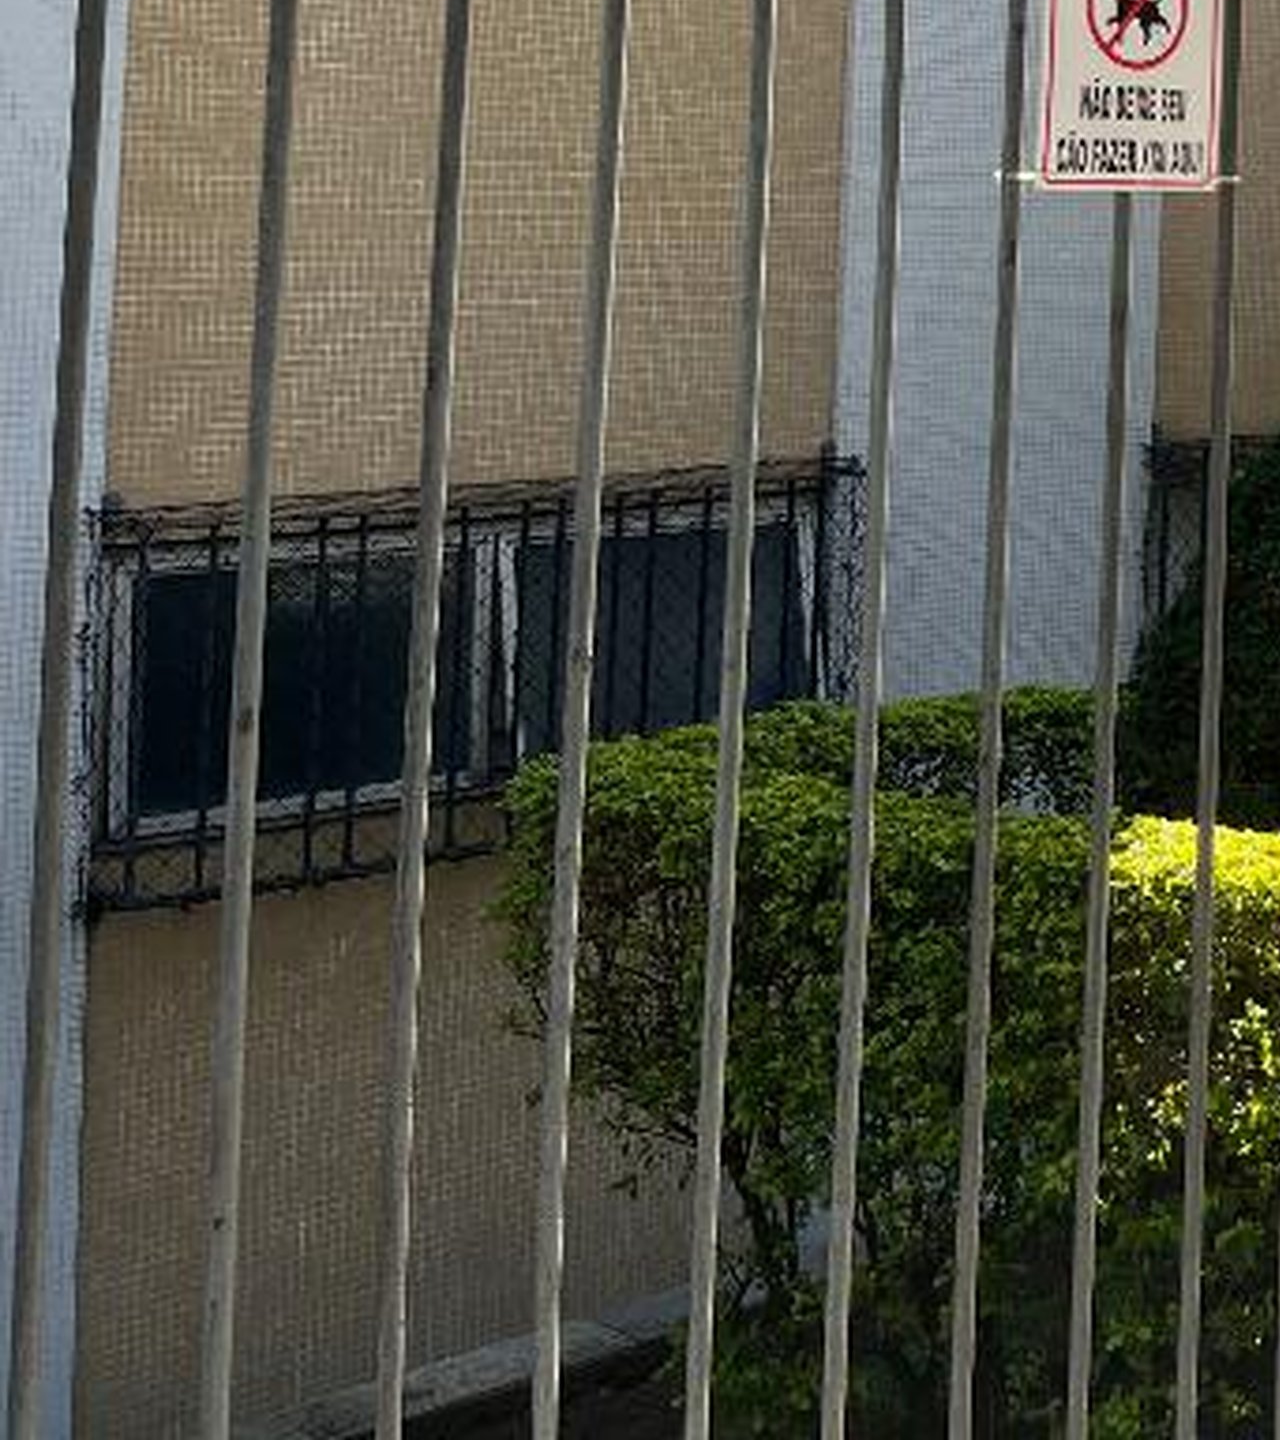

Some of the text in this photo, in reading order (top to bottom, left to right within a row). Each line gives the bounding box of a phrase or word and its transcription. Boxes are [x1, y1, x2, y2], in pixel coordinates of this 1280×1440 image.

[1079, 77, 1110, 120] NÃO
[1057, 131, 1088, 173] CÃO
[1091, 138, 1137, 173] FAZER
